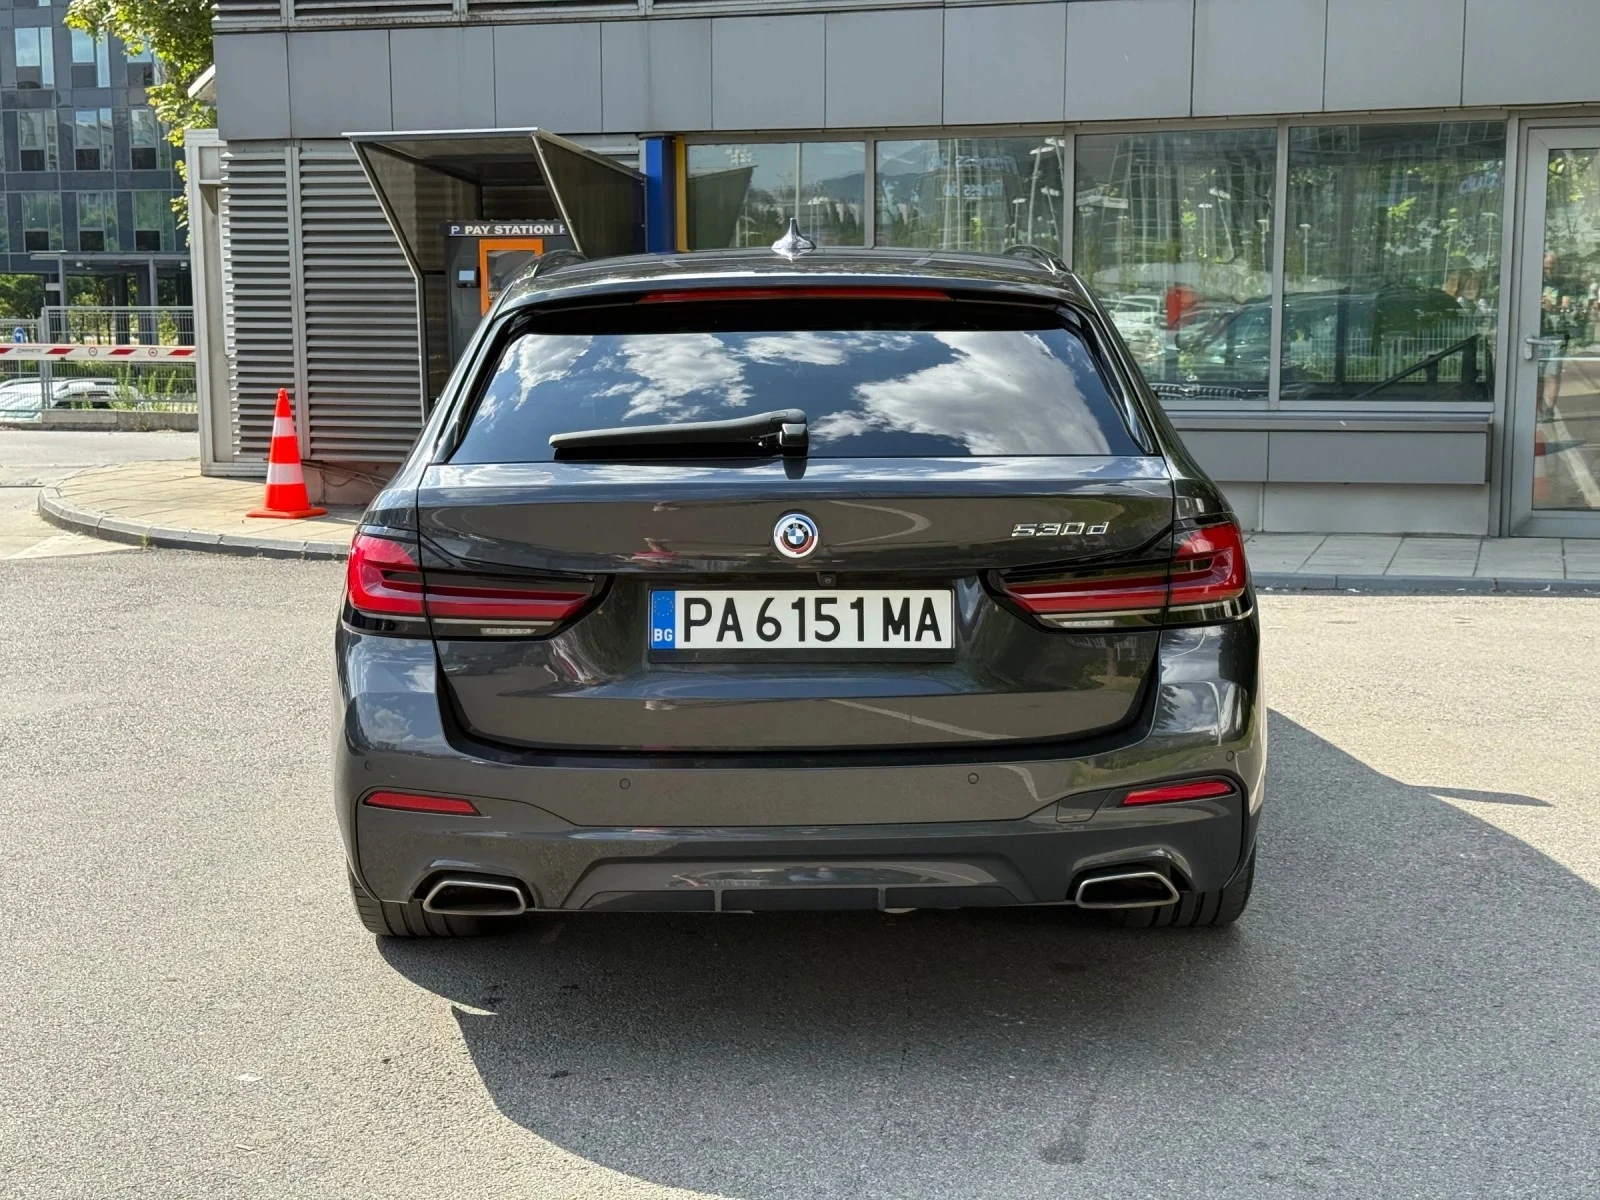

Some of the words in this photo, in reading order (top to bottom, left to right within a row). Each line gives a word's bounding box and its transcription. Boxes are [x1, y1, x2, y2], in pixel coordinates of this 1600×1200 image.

[451, 226, 460, 234] P
[465, 226, 490, 234] PAY
[494, 225, 554, 234] STATION
[1011, 522, 1109, 537] 530d
[684, 597, 743, 642] PA
[756, 597, 864, 642] 6151
[882, 597, 942, 642] MA
[653, 628, 673, 642] BG
